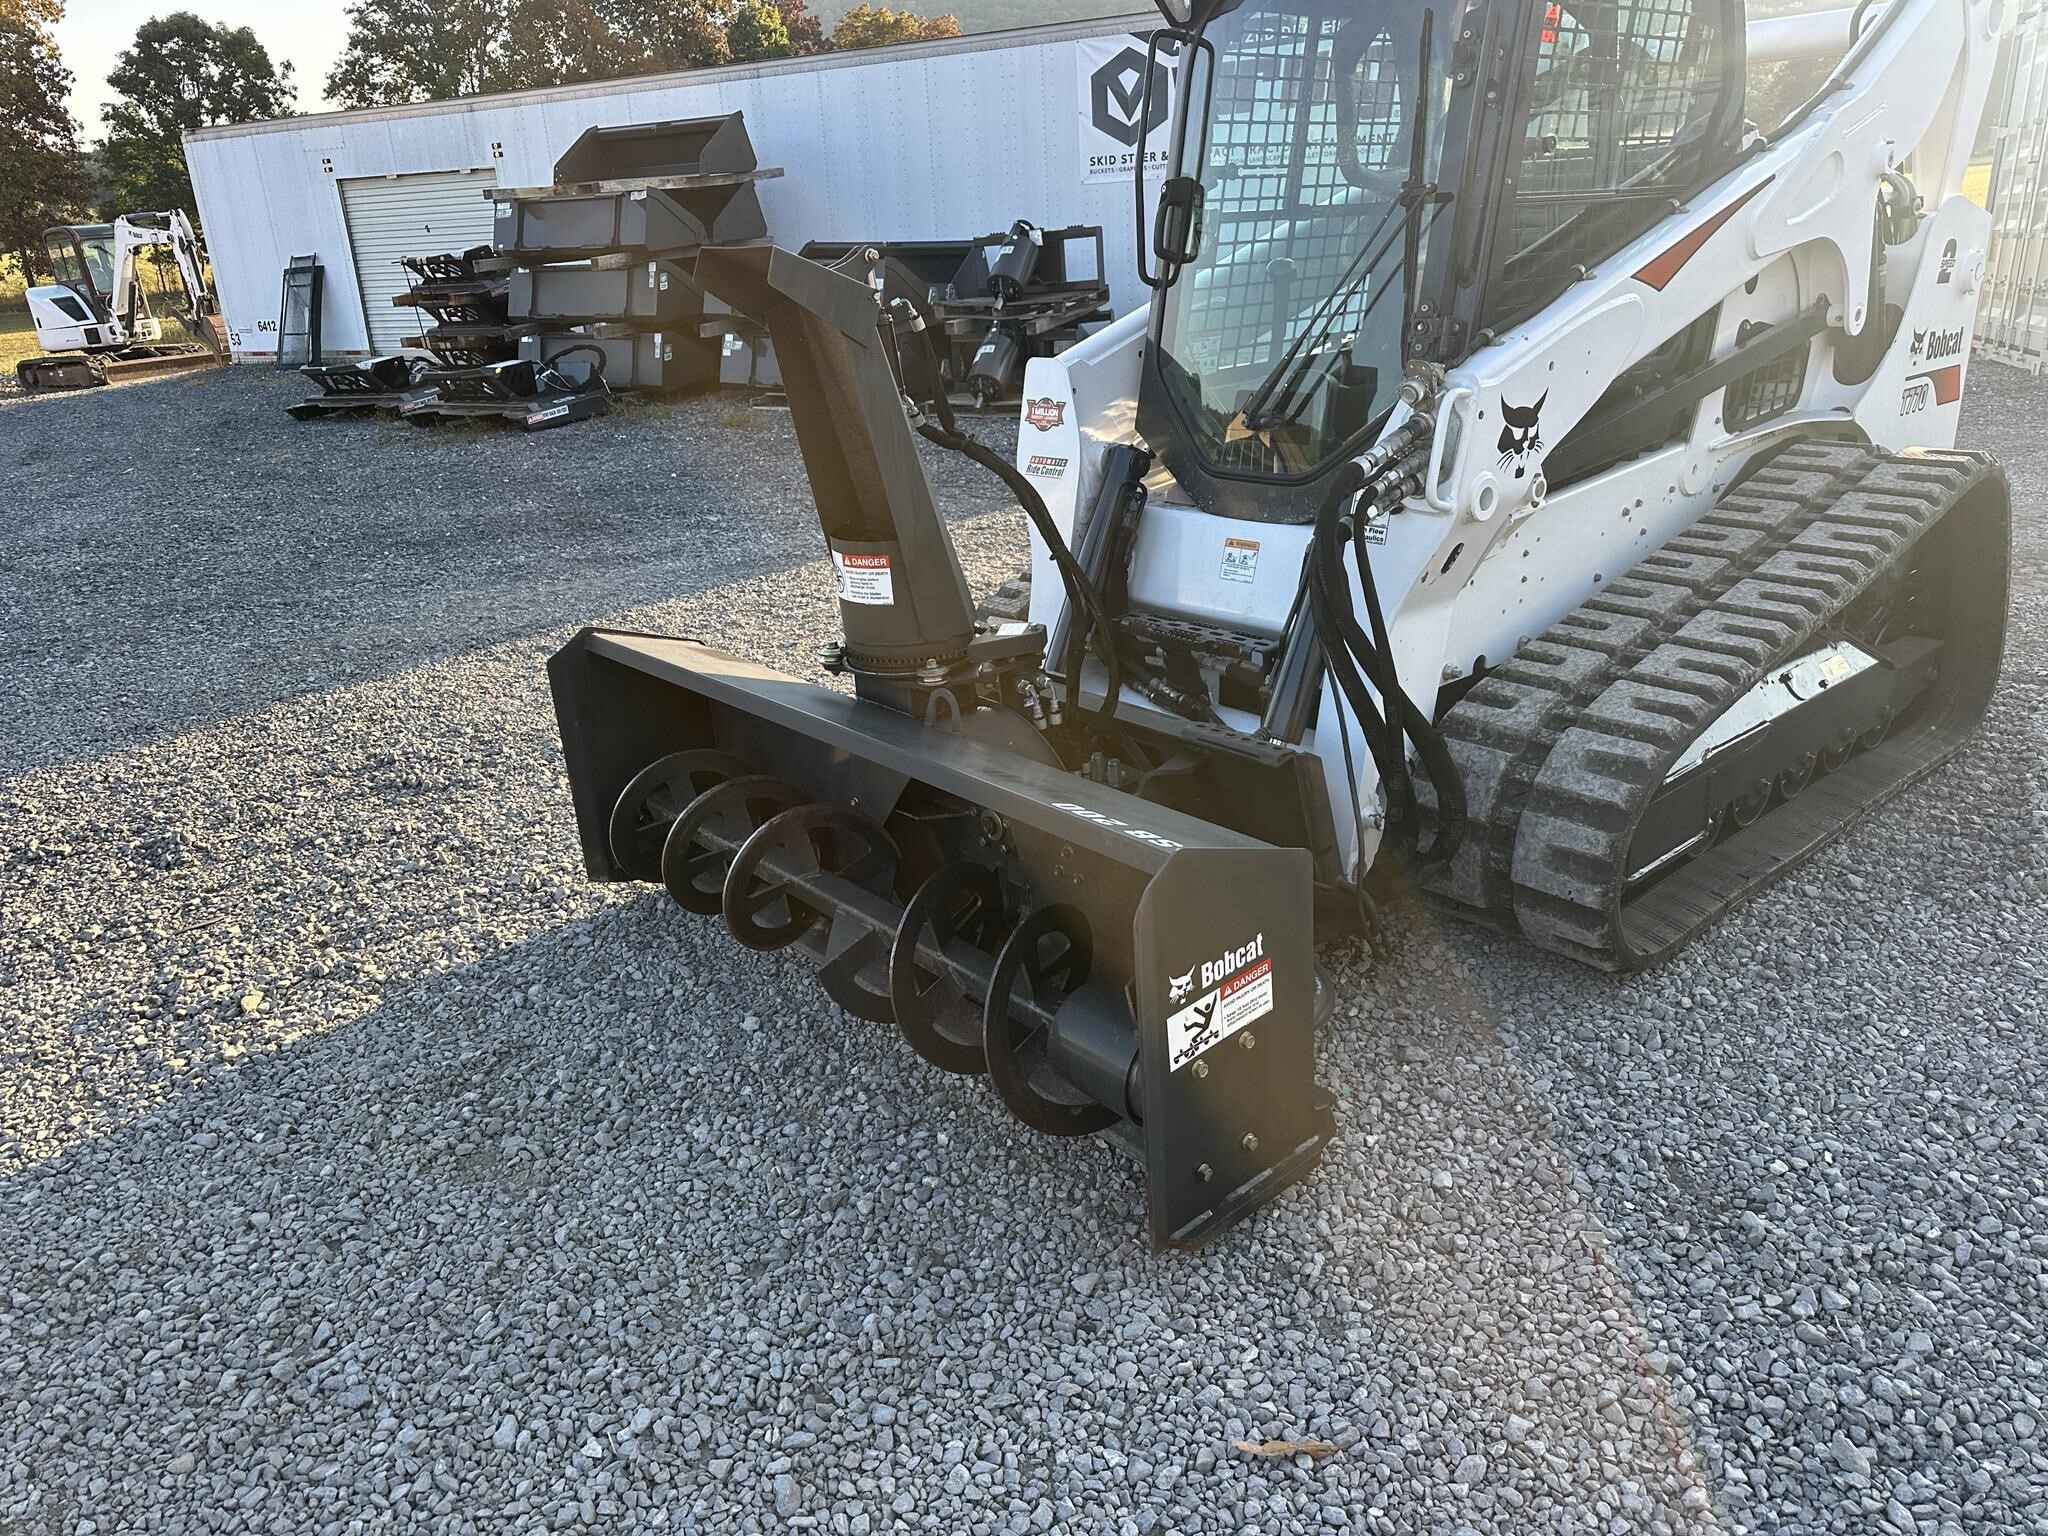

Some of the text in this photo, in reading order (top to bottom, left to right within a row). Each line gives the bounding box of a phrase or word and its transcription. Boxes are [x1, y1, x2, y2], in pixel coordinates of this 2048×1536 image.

[1089, 150, 1169, 167] SKID STER &
[1089, 167, 1115, 175] BUCKETS
[1936, 238, 1957, 284] 2
[1940, 259, 1956, 269] SPEED
[257, 320, 278, 332] 6412
[230, 333, 242, 346] 53
[1926, 327, 1964, 361] Bobcat
[1899, 382, 1929, 417] T770
[1035, 408, 1059, 417] MILLION
[1030, 455, 1068, 467] AUTOMATIC
[1026, 464, 1065, 477] Ride Control
[1369, 527, 1385, 535] Flow
[852, 557, 887, 566] DANGER
[1051, 802, 1184, 848] SB 200
[1201, 932, 1264, 989] Bobcat
[1233, 963, 1269, 991] DANGER
